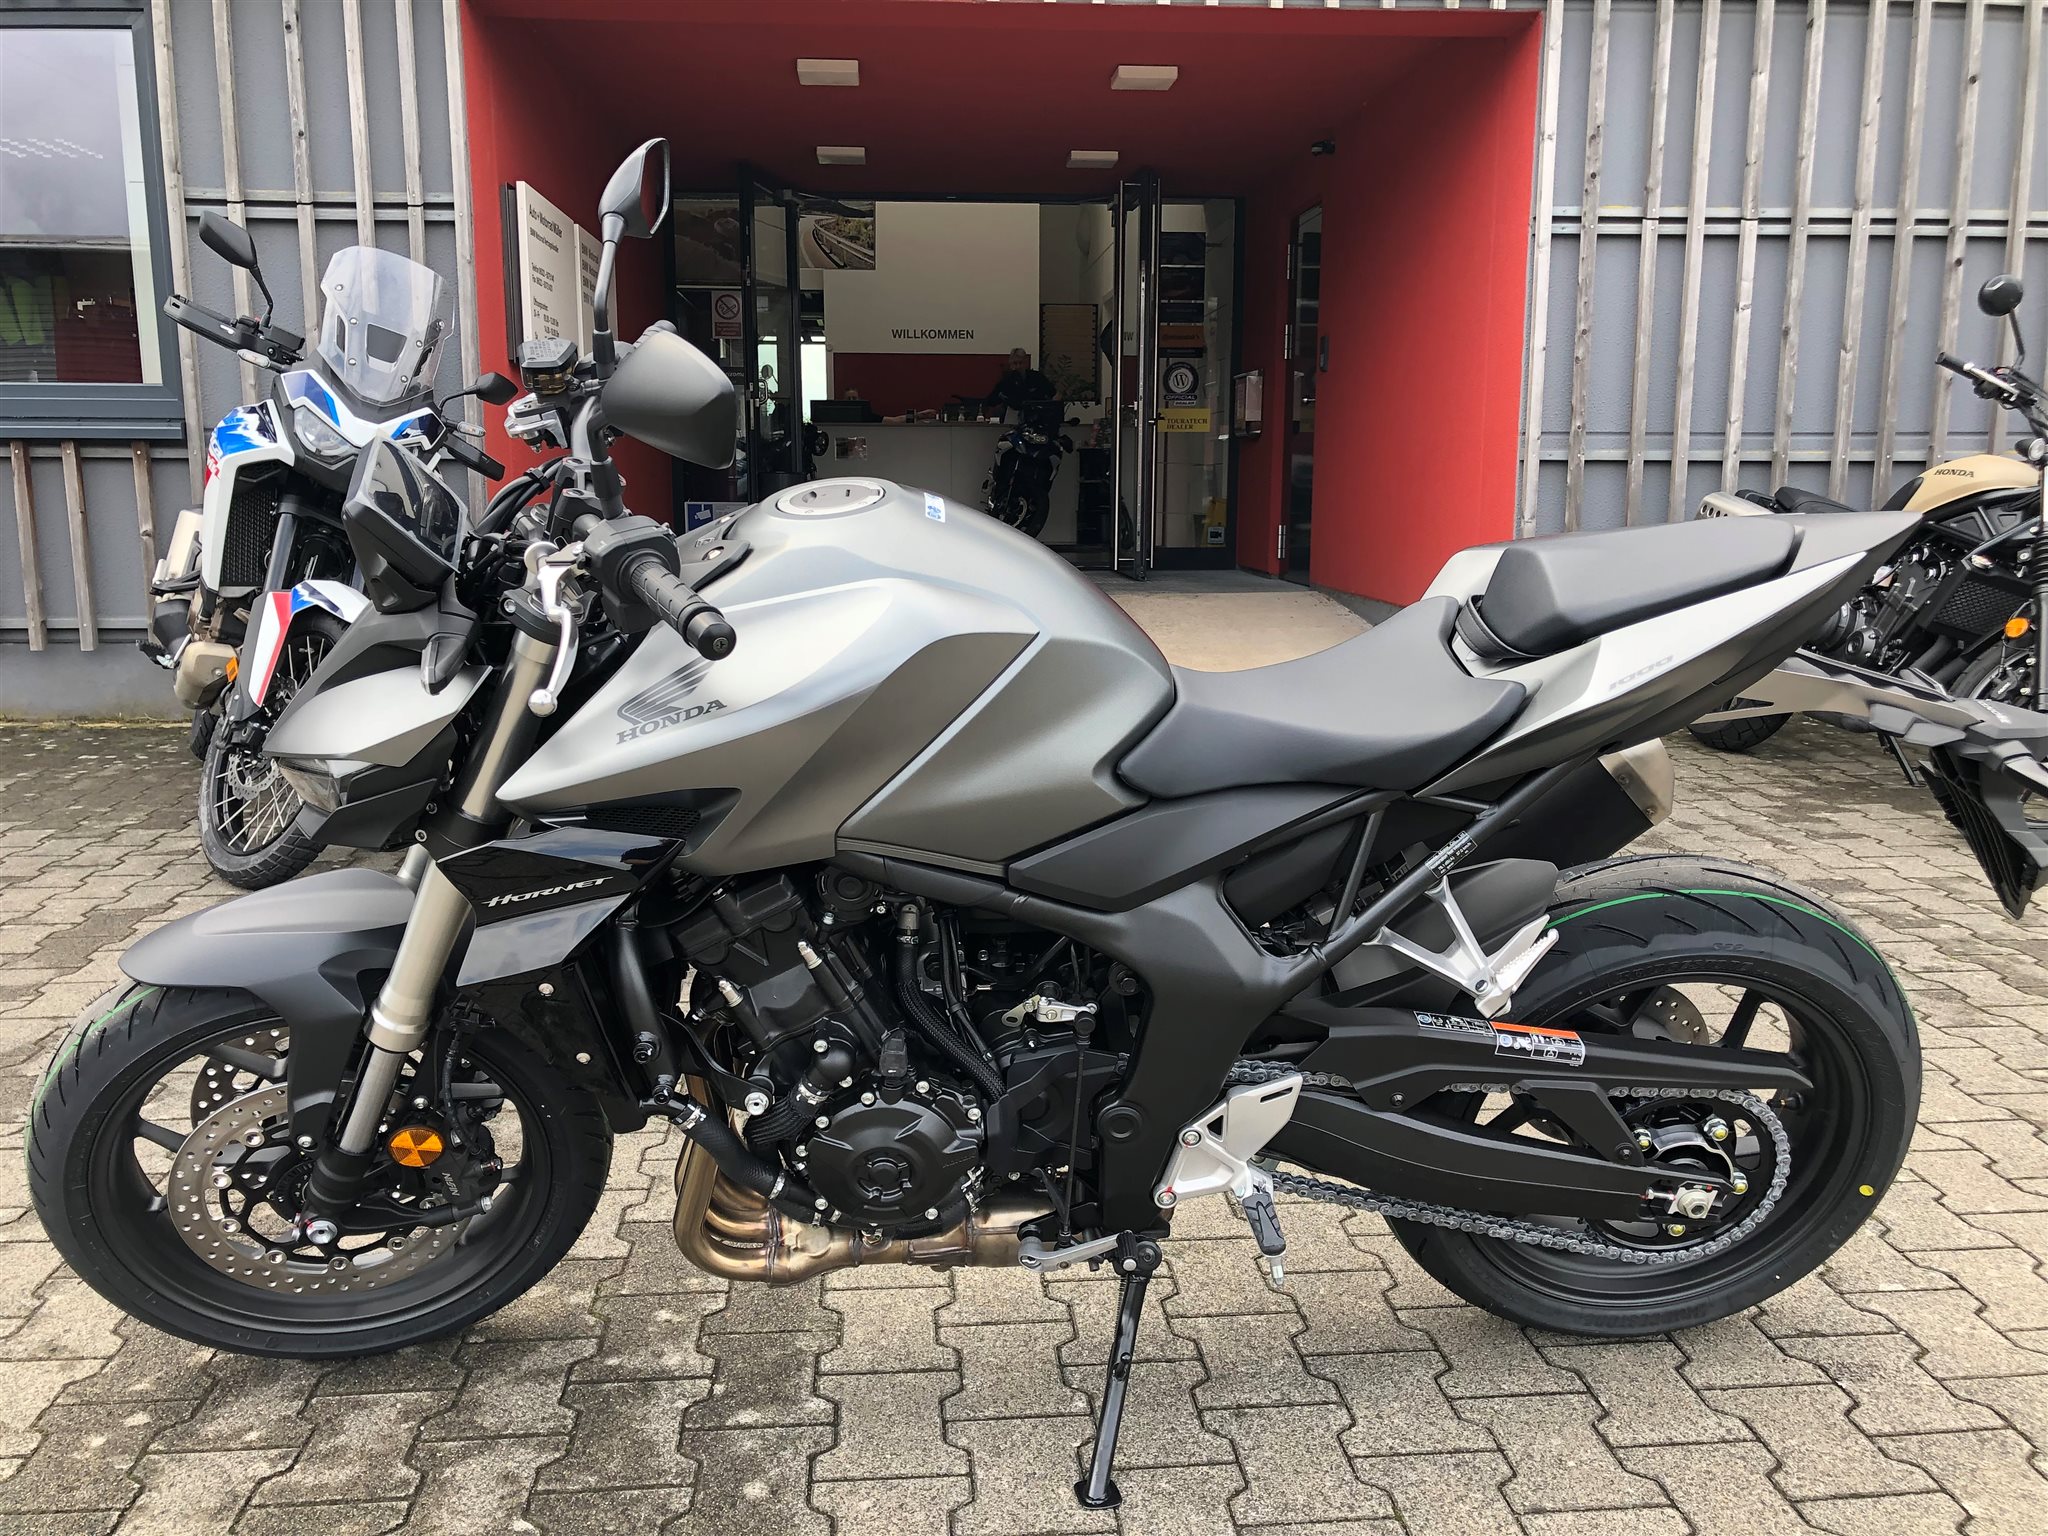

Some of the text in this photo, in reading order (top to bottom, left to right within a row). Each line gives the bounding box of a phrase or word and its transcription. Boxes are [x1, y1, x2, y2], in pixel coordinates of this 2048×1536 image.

[891, 328, 974, 340] WILLKOMMEN
[1934, 468, 1975, 478] HONDA
[1608, 655, 1674, 690] 1000
[616, 699, 728, 745] HONDA
